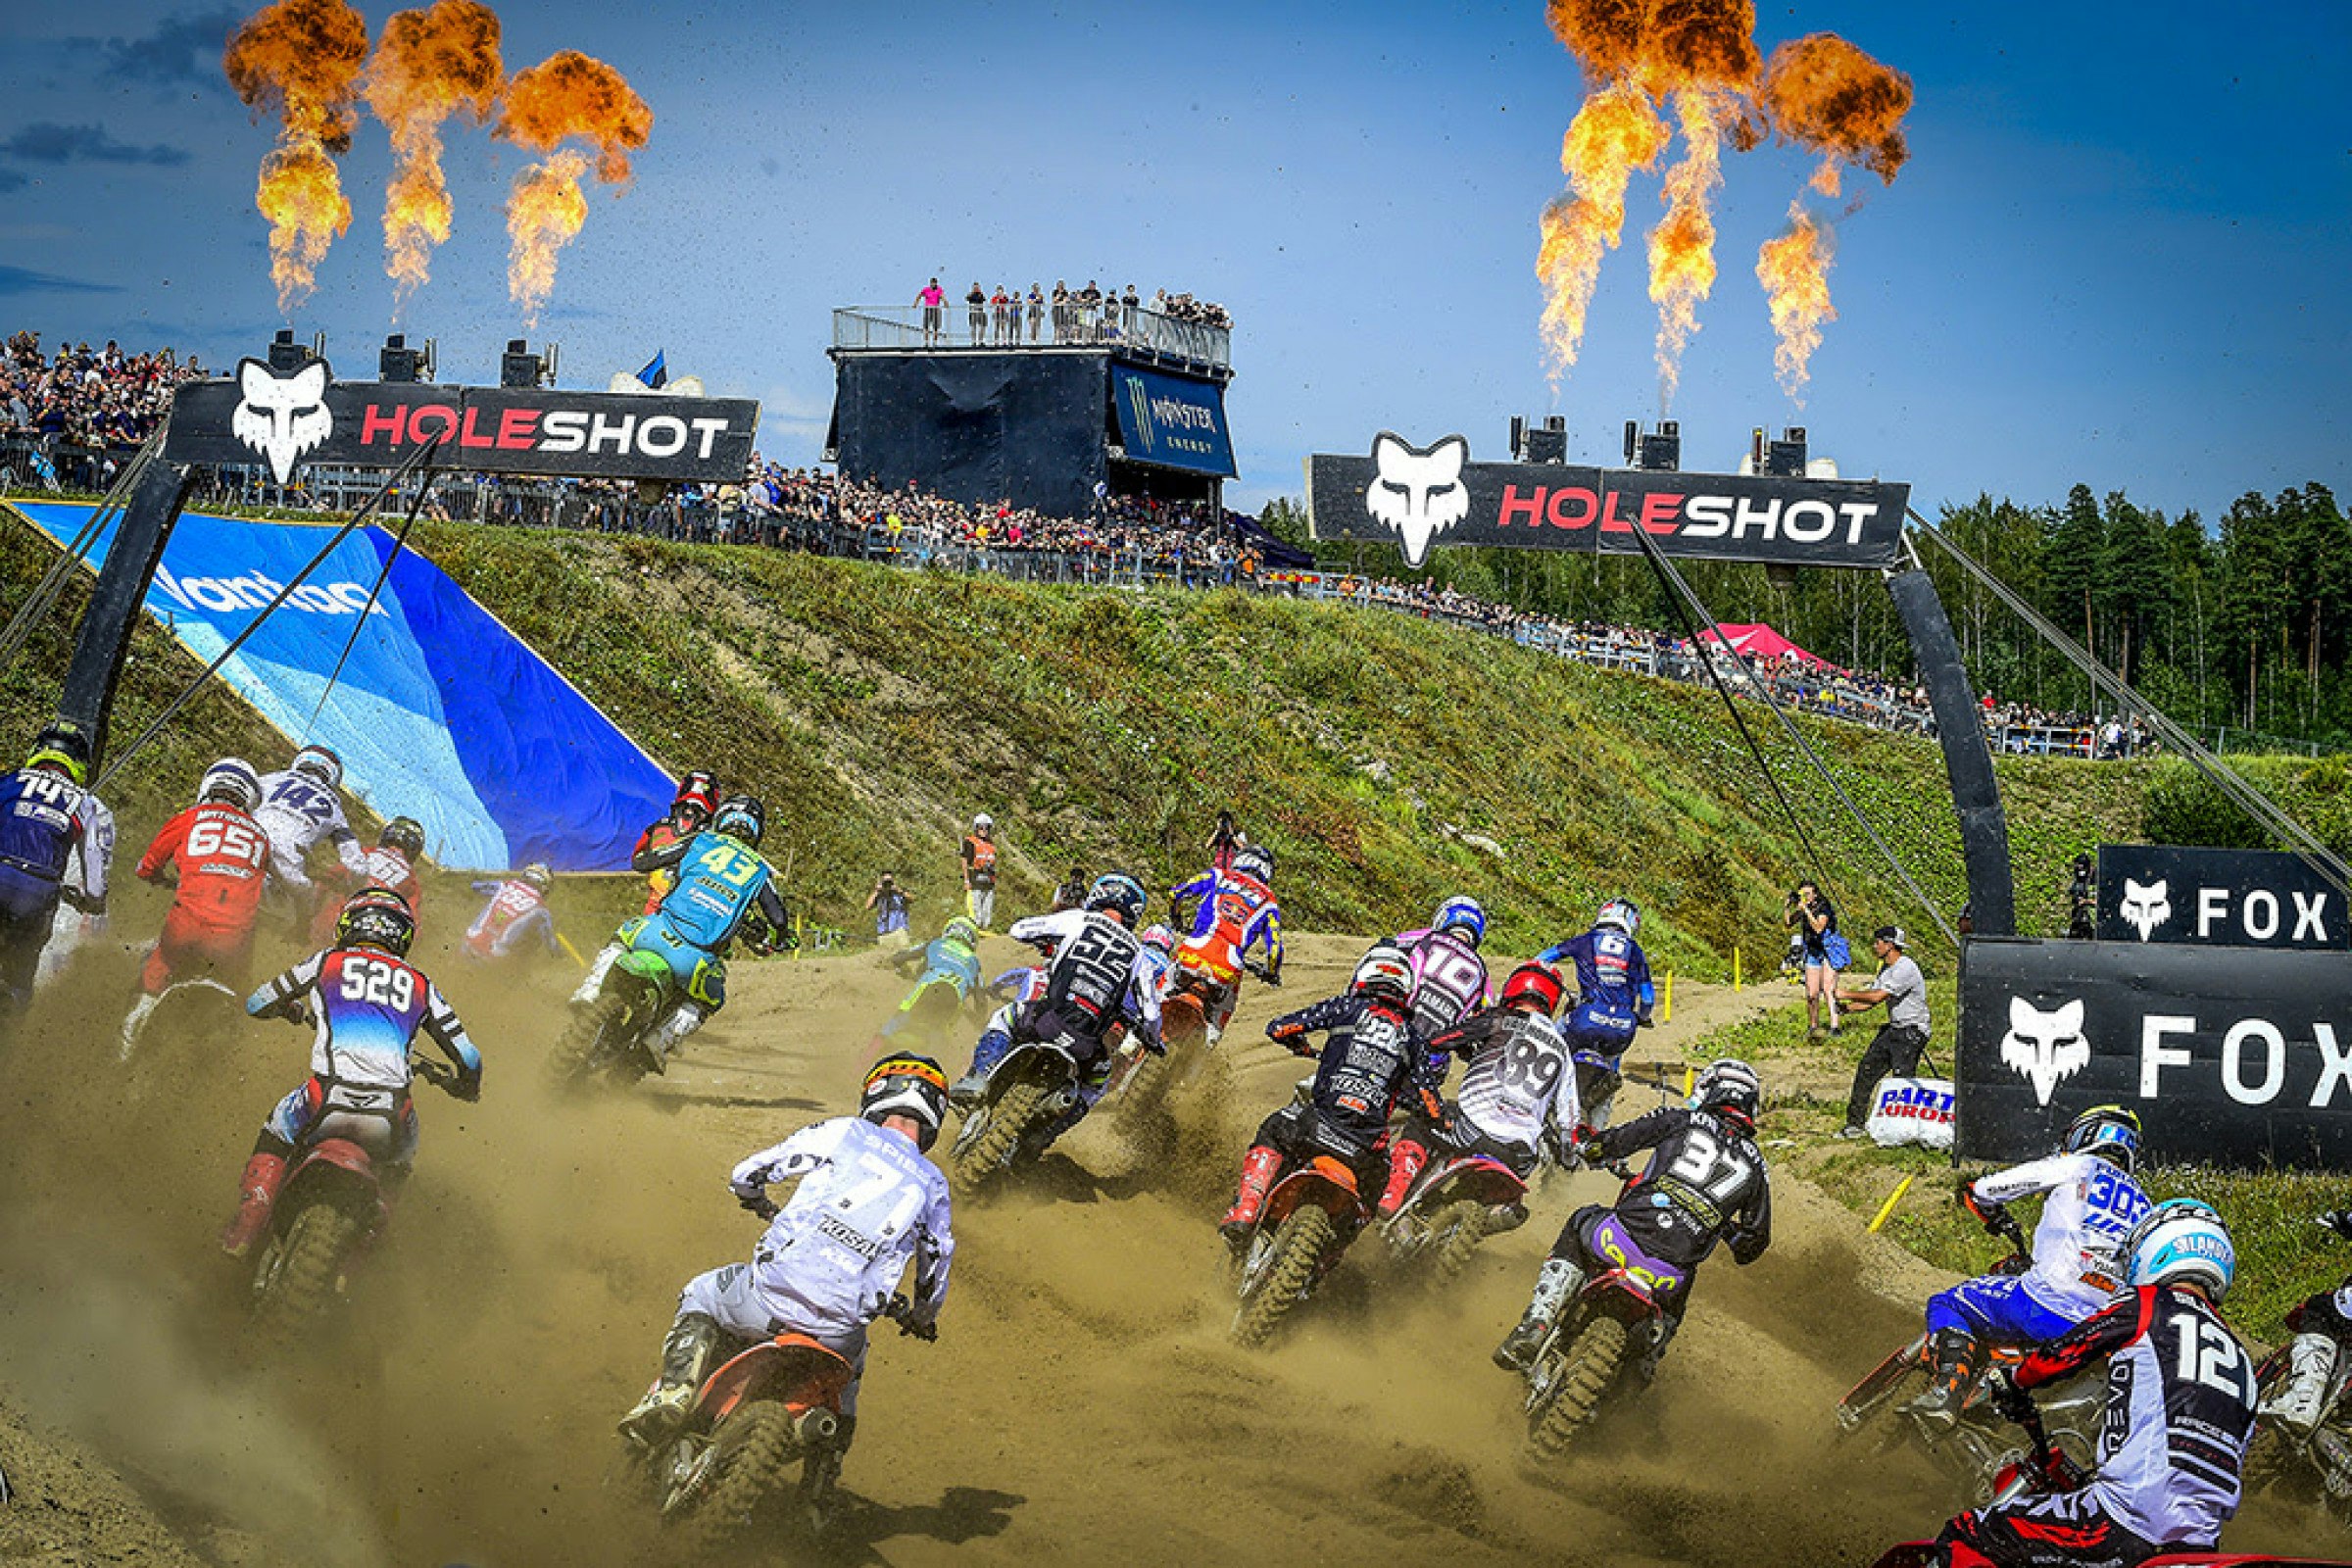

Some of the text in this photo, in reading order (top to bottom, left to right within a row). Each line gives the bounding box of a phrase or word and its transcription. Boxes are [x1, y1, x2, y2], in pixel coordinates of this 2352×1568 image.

[360, 404, 728, 459] HOLESHOT
[1151, 396, 1216, 434] MONSTER
[1167, 436, 1211, 454] ENERGY
[1497, 484, 1879, 545] HOLESHOT
[187, 821, 265, 869] 651
[699, 845, 760, 886] 43
[2197, 888, 2328, 942] FOX
[1071, 924, 1136, 983] 52
[1422, 945, 1481, 1000] 10
[1599, 935, 1627, 955] 6
[341, 956, 415, 1013] 529
[2139, 1015, 2352, 1107] FOX
[1876, 1104, 1956, 1123] UROP
[839, 1150, 927, 1238] 71
[1668, 1130, 1752, 1203] 37
